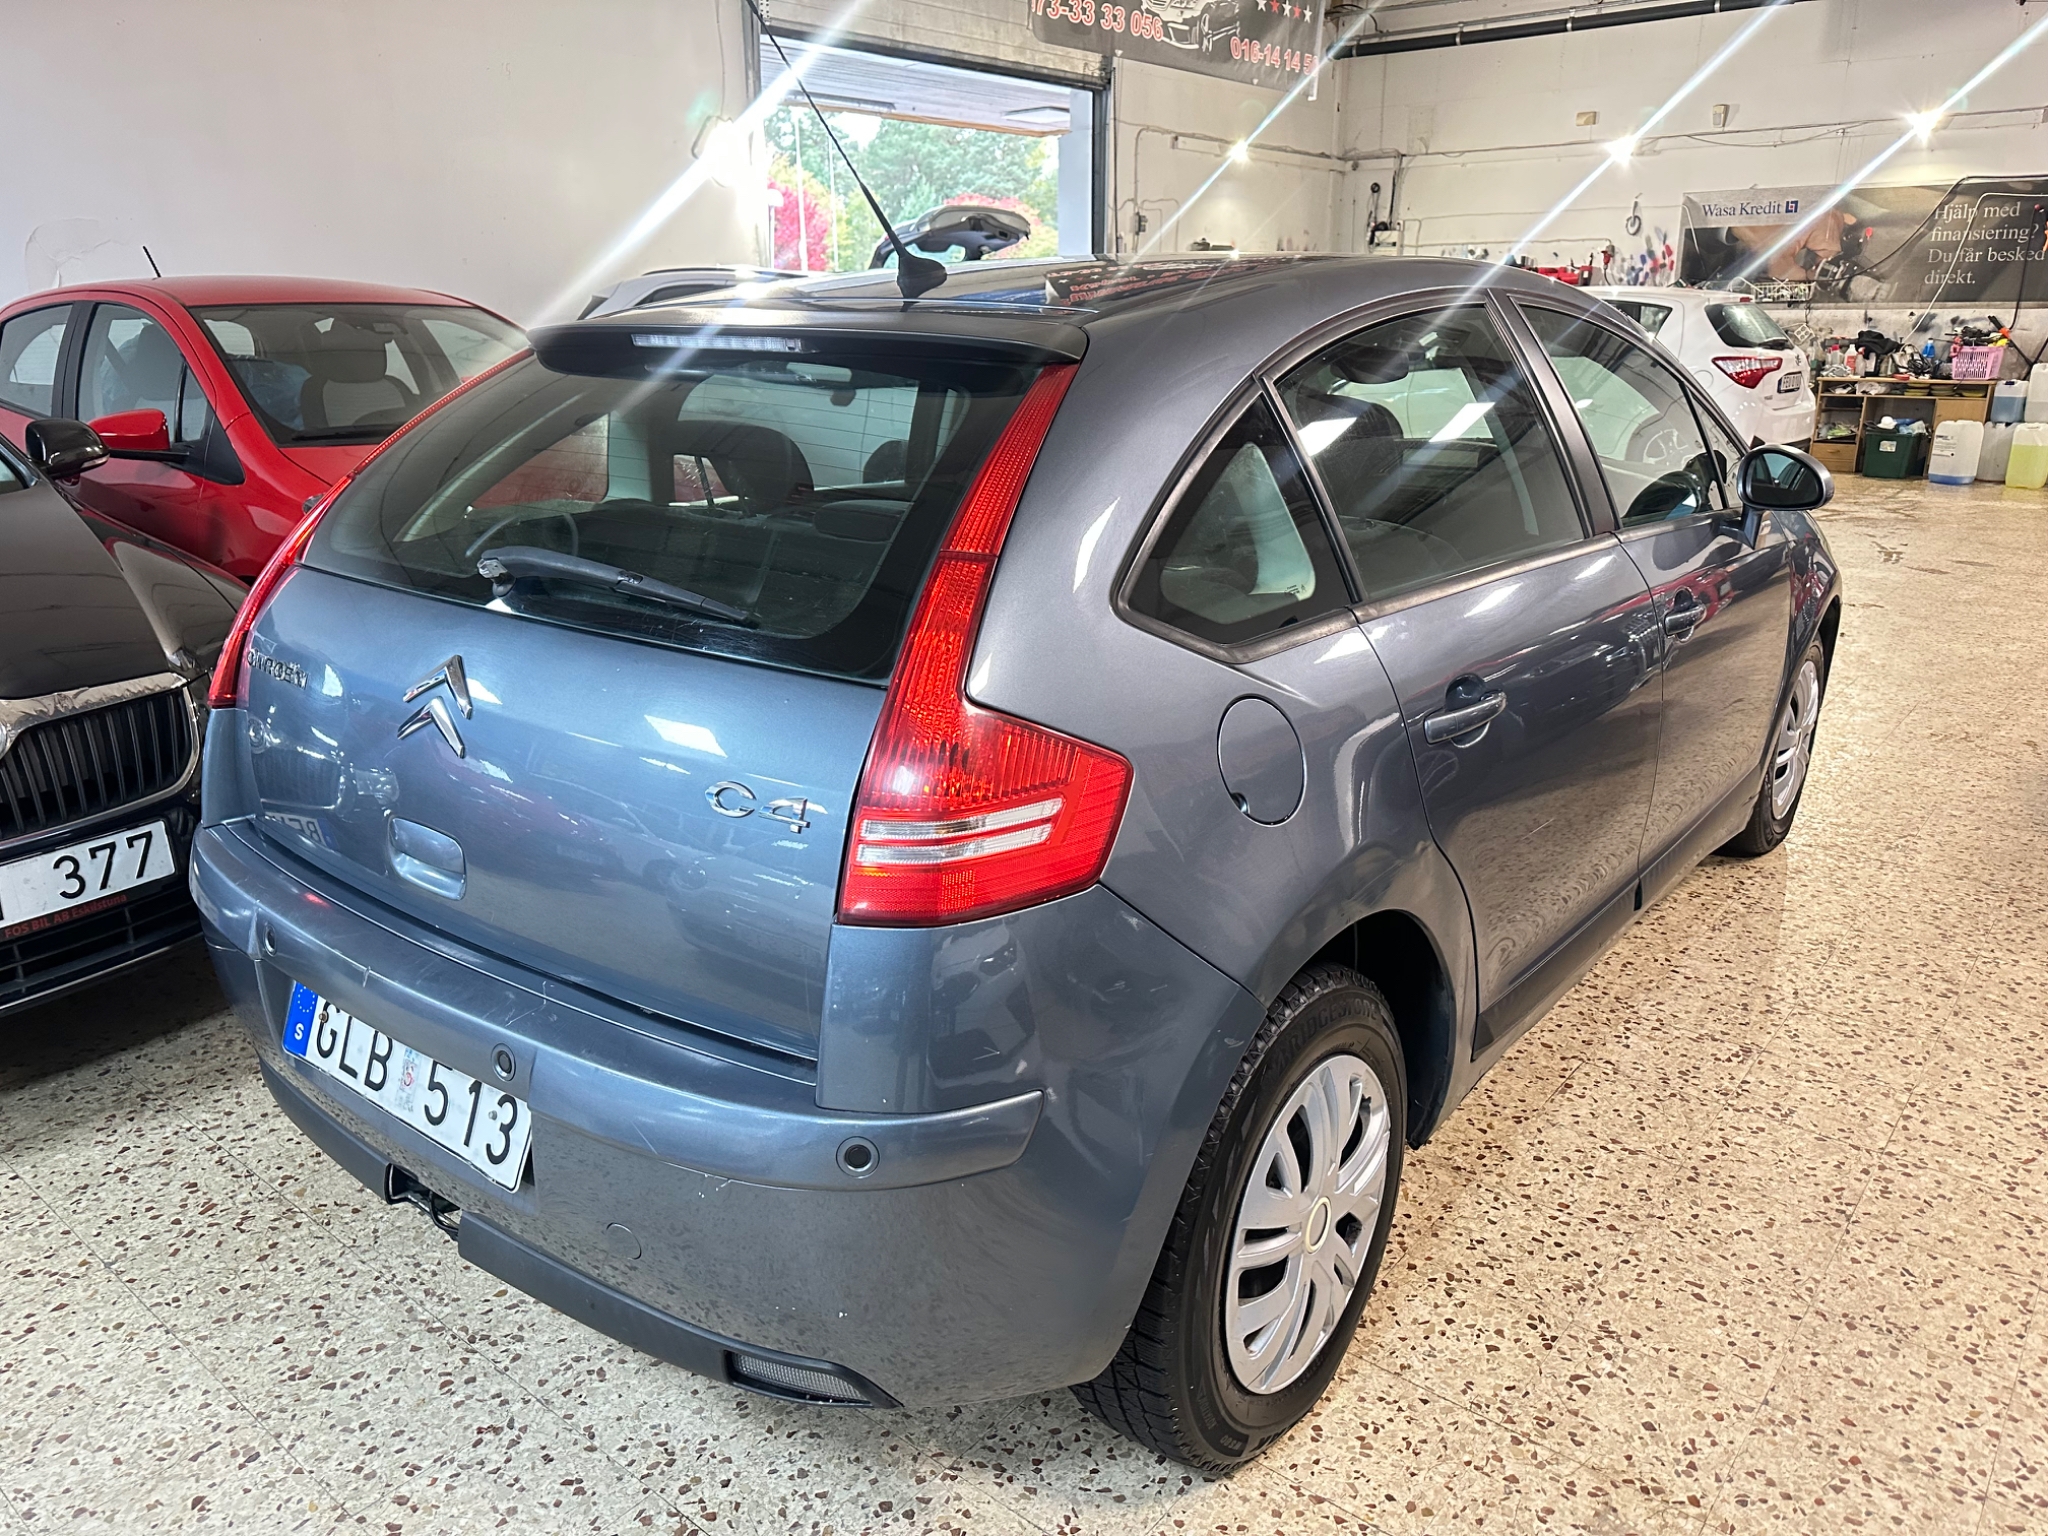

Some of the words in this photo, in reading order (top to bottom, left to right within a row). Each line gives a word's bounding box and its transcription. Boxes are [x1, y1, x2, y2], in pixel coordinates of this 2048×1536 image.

[1031, 0, 1096, 25] 73-33
[1100, 3, 1126, 33] 33
[1130, 10, 1164, 42] 056
[1230, 36, 1281, 68] 016-14
[1284, 48, 1301, 73] 14
[1702, 203, 1736, 217] Wasa
[1739, 201, 1782, 215] Kredit
[1934, 203, 1979, 223] Hjälp
[1983, 202, 2021, 217] med
[1928, 248, 1953, 263] Du
[1959, 247, 1983, 263] får
[1987, 246, 2045, 262] besked
[704, 779, 812, 835] C4
[52, 830, 153, 899] 377
[4, 922, 30, 938] FOS
[31, 917, 52, 931] BIL
[53, 910, 70, 924] AB
[294, 1023, 305, 1040] S
[316, 1001, 393, 1091] GLB
[424, 1060, 518, 1165] 513
